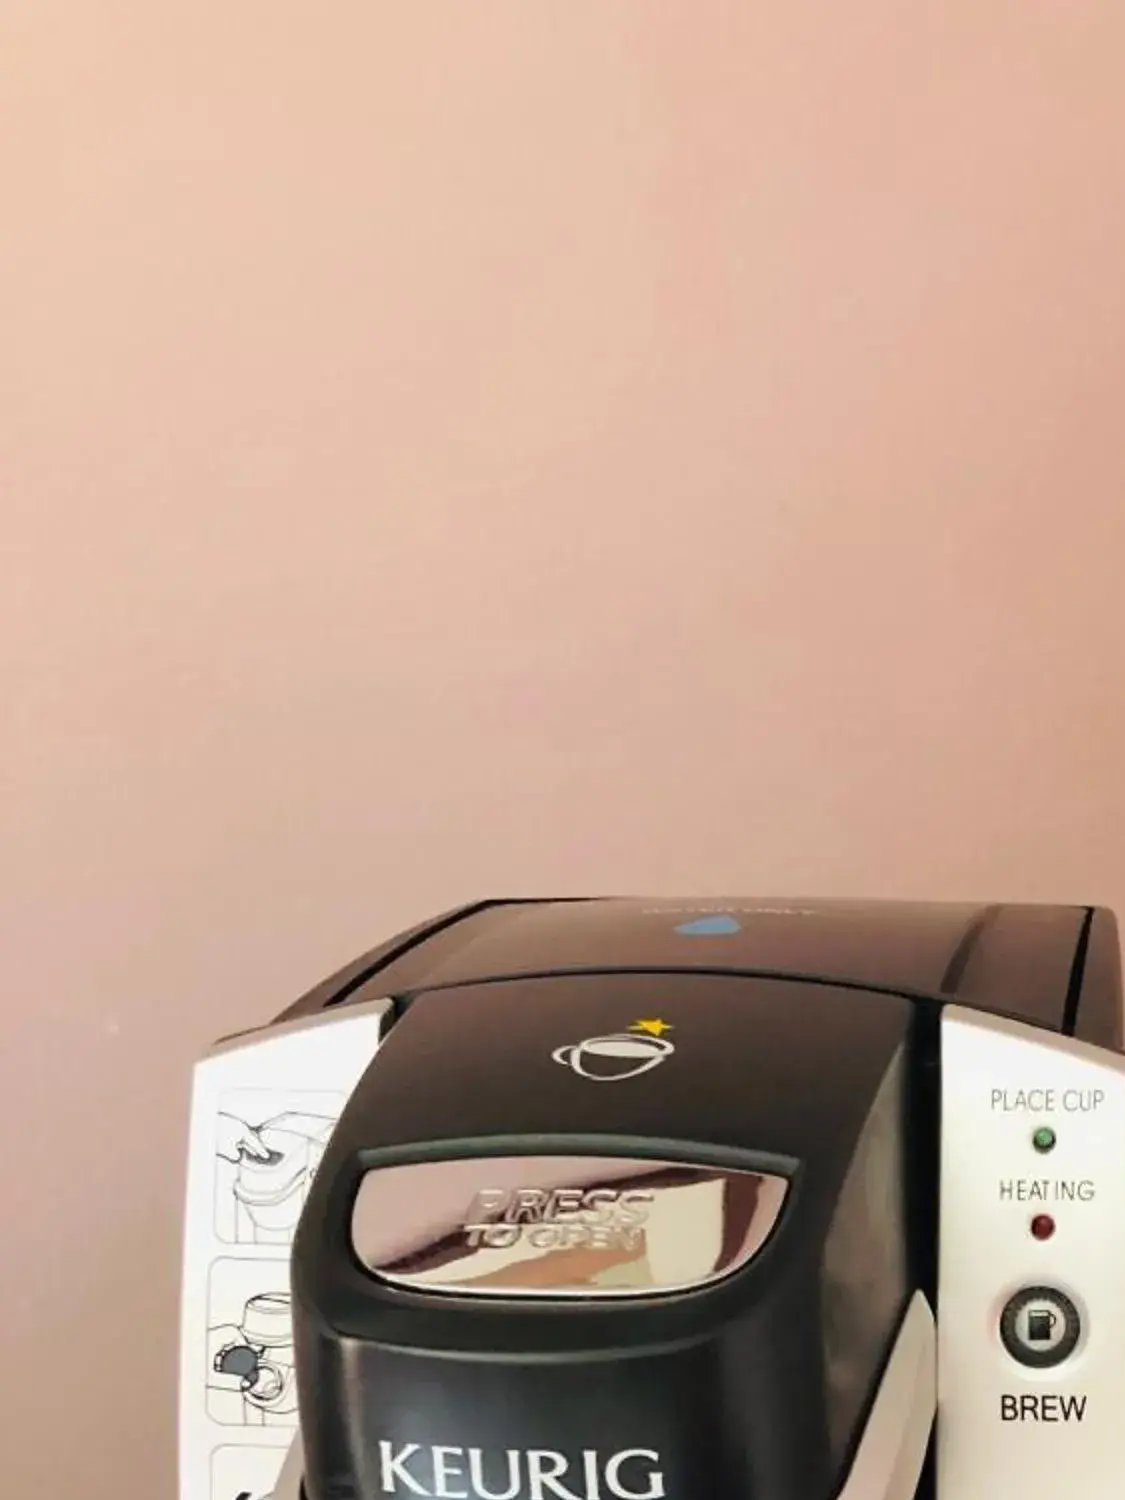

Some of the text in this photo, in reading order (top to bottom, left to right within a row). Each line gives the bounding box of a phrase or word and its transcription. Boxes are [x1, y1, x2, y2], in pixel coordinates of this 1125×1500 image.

[991, 1088, 1105, 1112] PLACE CUP
[1000, 1179, 1096, 1201] HEATING
[467, 1189, 655, 1226] PRESS
[464, 1224, 646, 1252] TO OPEN
[1001, 1394, 1087, 1422] BREW
